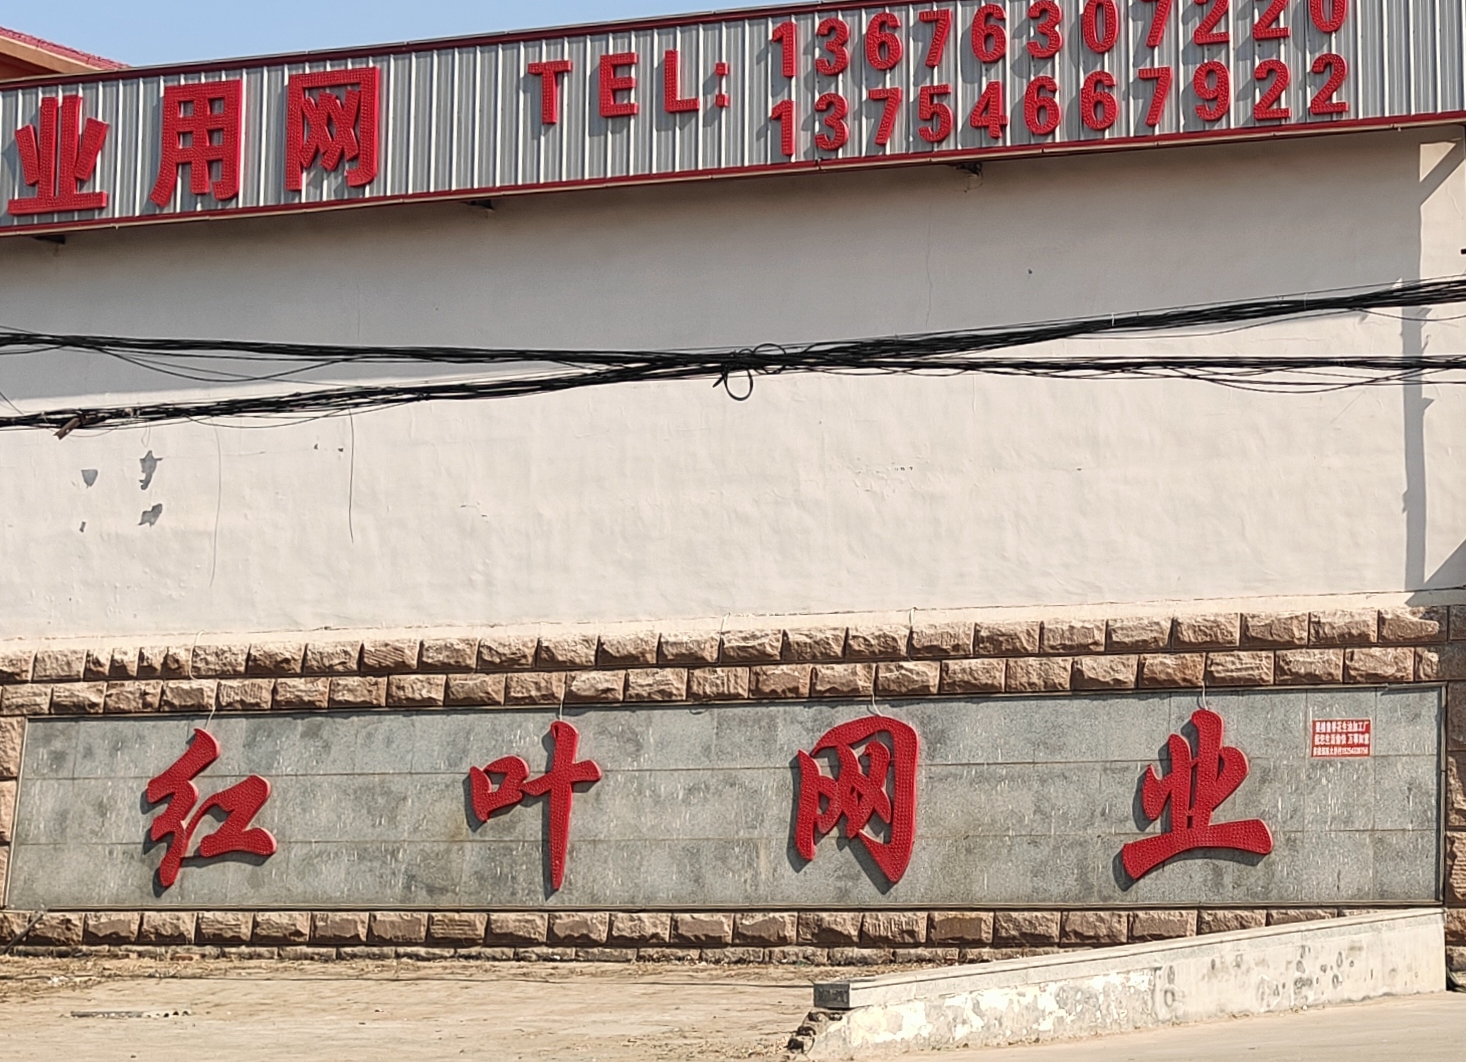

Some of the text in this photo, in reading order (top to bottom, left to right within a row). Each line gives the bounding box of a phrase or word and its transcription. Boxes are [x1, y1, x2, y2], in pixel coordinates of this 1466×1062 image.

[8, 66, 381, 215] 业用网
[528, 49, 730, 124] TEL:
[770, 52, 1350, 157] 13754667922
[147, 708, 1274, 889] 红叶网业
